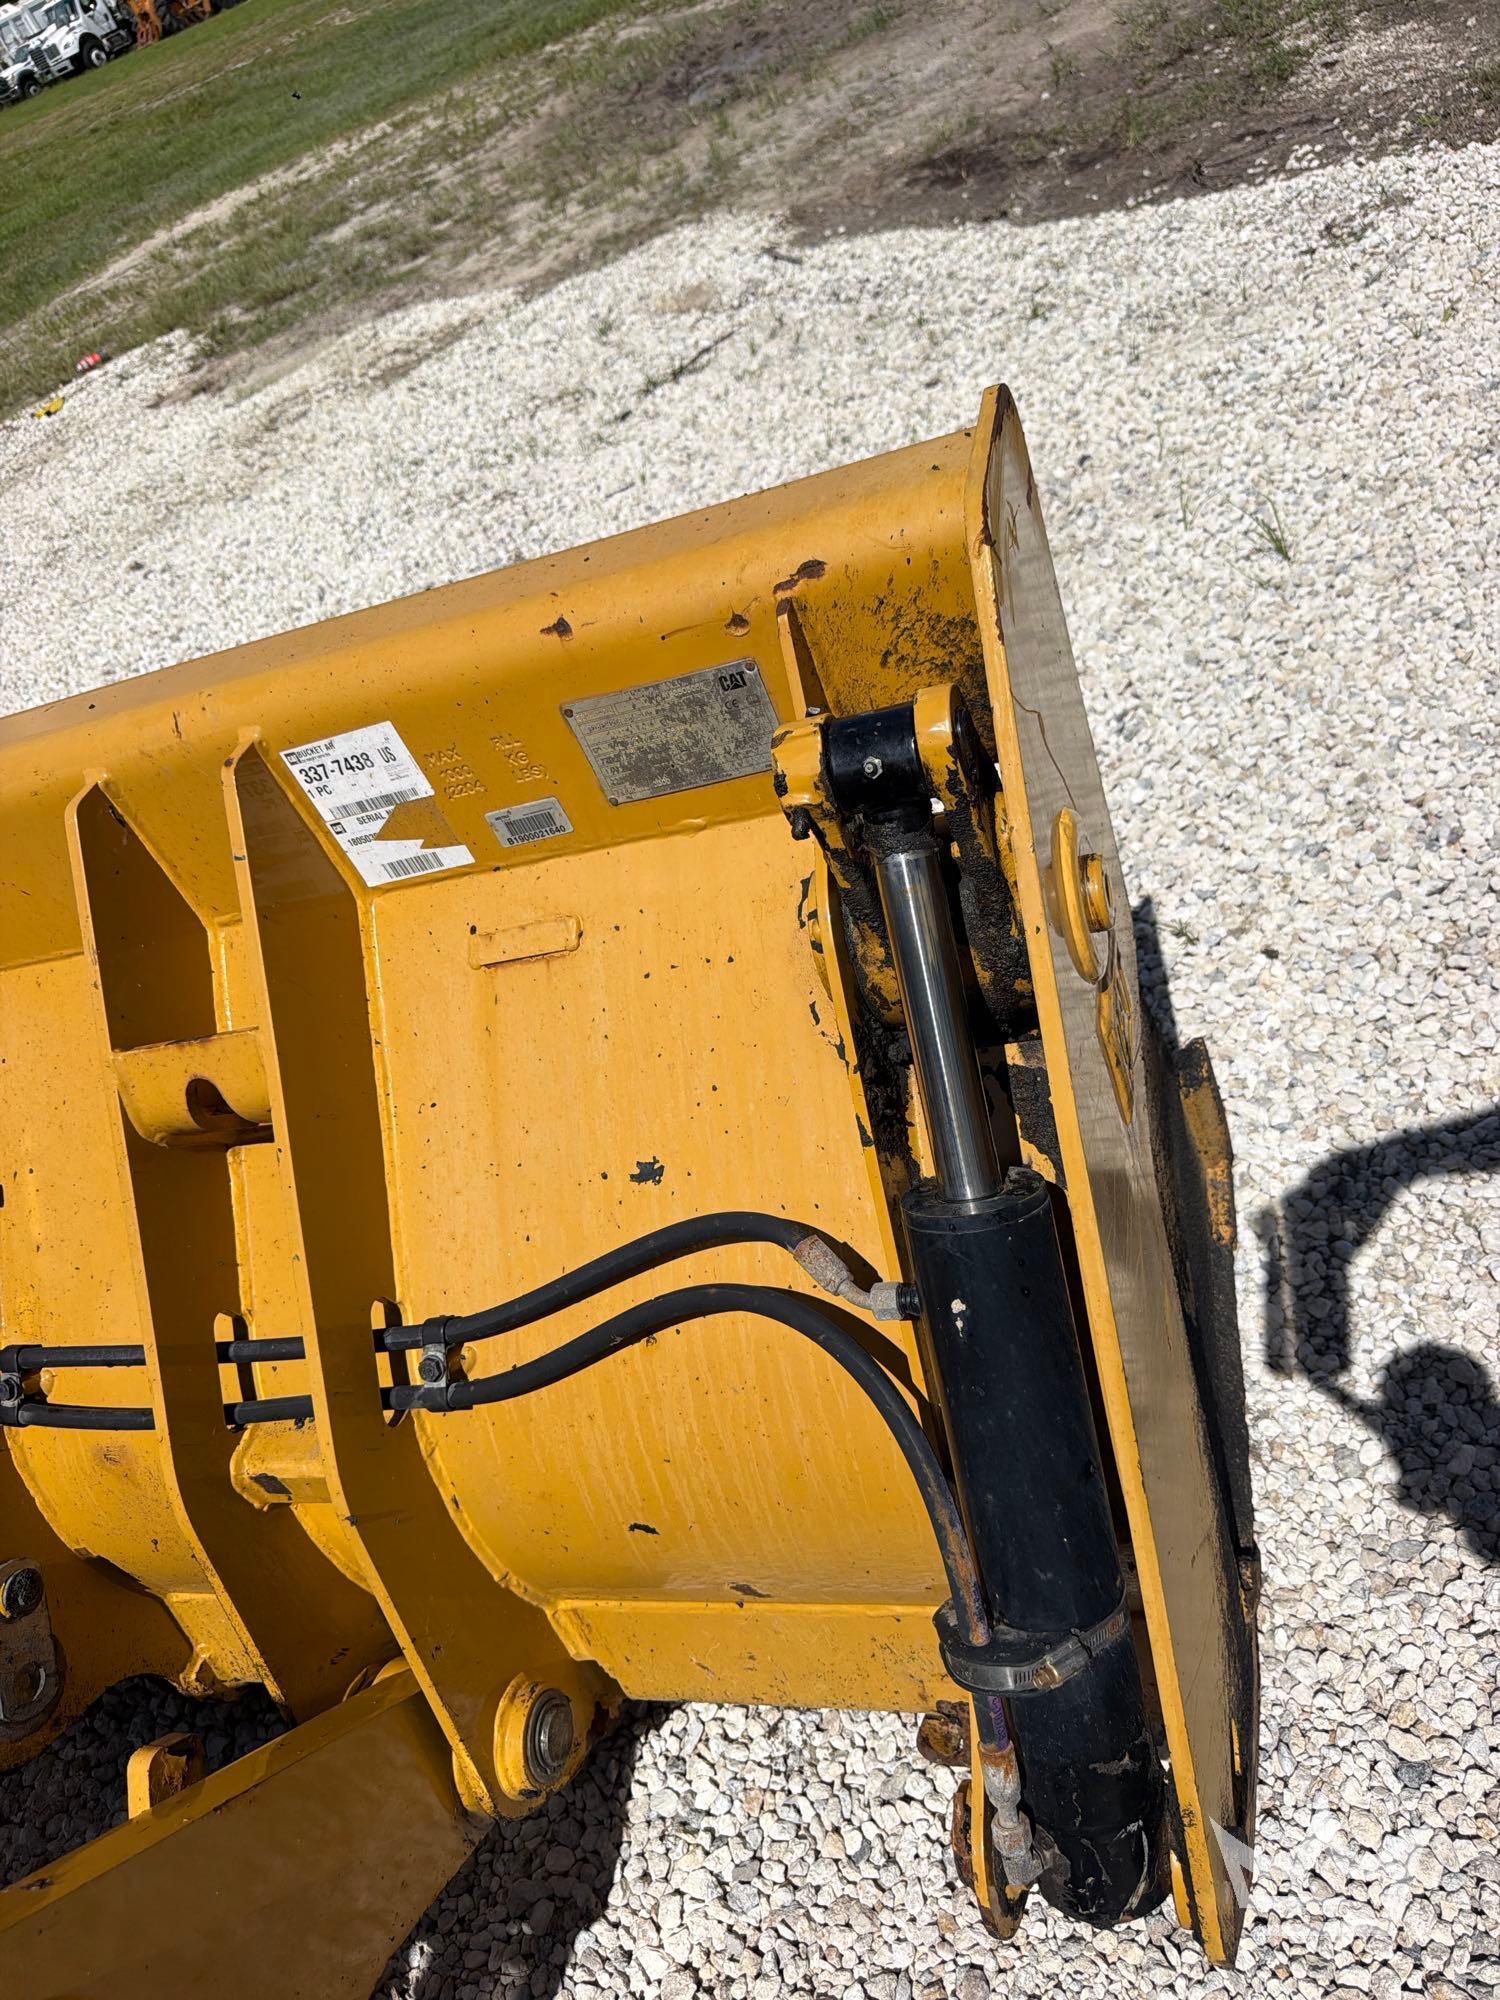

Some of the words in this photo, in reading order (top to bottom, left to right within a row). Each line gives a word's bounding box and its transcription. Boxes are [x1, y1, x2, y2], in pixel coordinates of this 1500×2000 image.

[719, 671, 747, 692] CAT
[297, 745, 323, 759] BUCKET
[424, 742, 462, 767] MAX
[504, 750, 529, 768] KG
[299, 752, 375, 785] 337-7438
[377, 746, 397, 763] US
[307, 789, 316, 799] 1
[315, 784, 333, 797] PC
[356, 811, 387, 825] SERIAL
